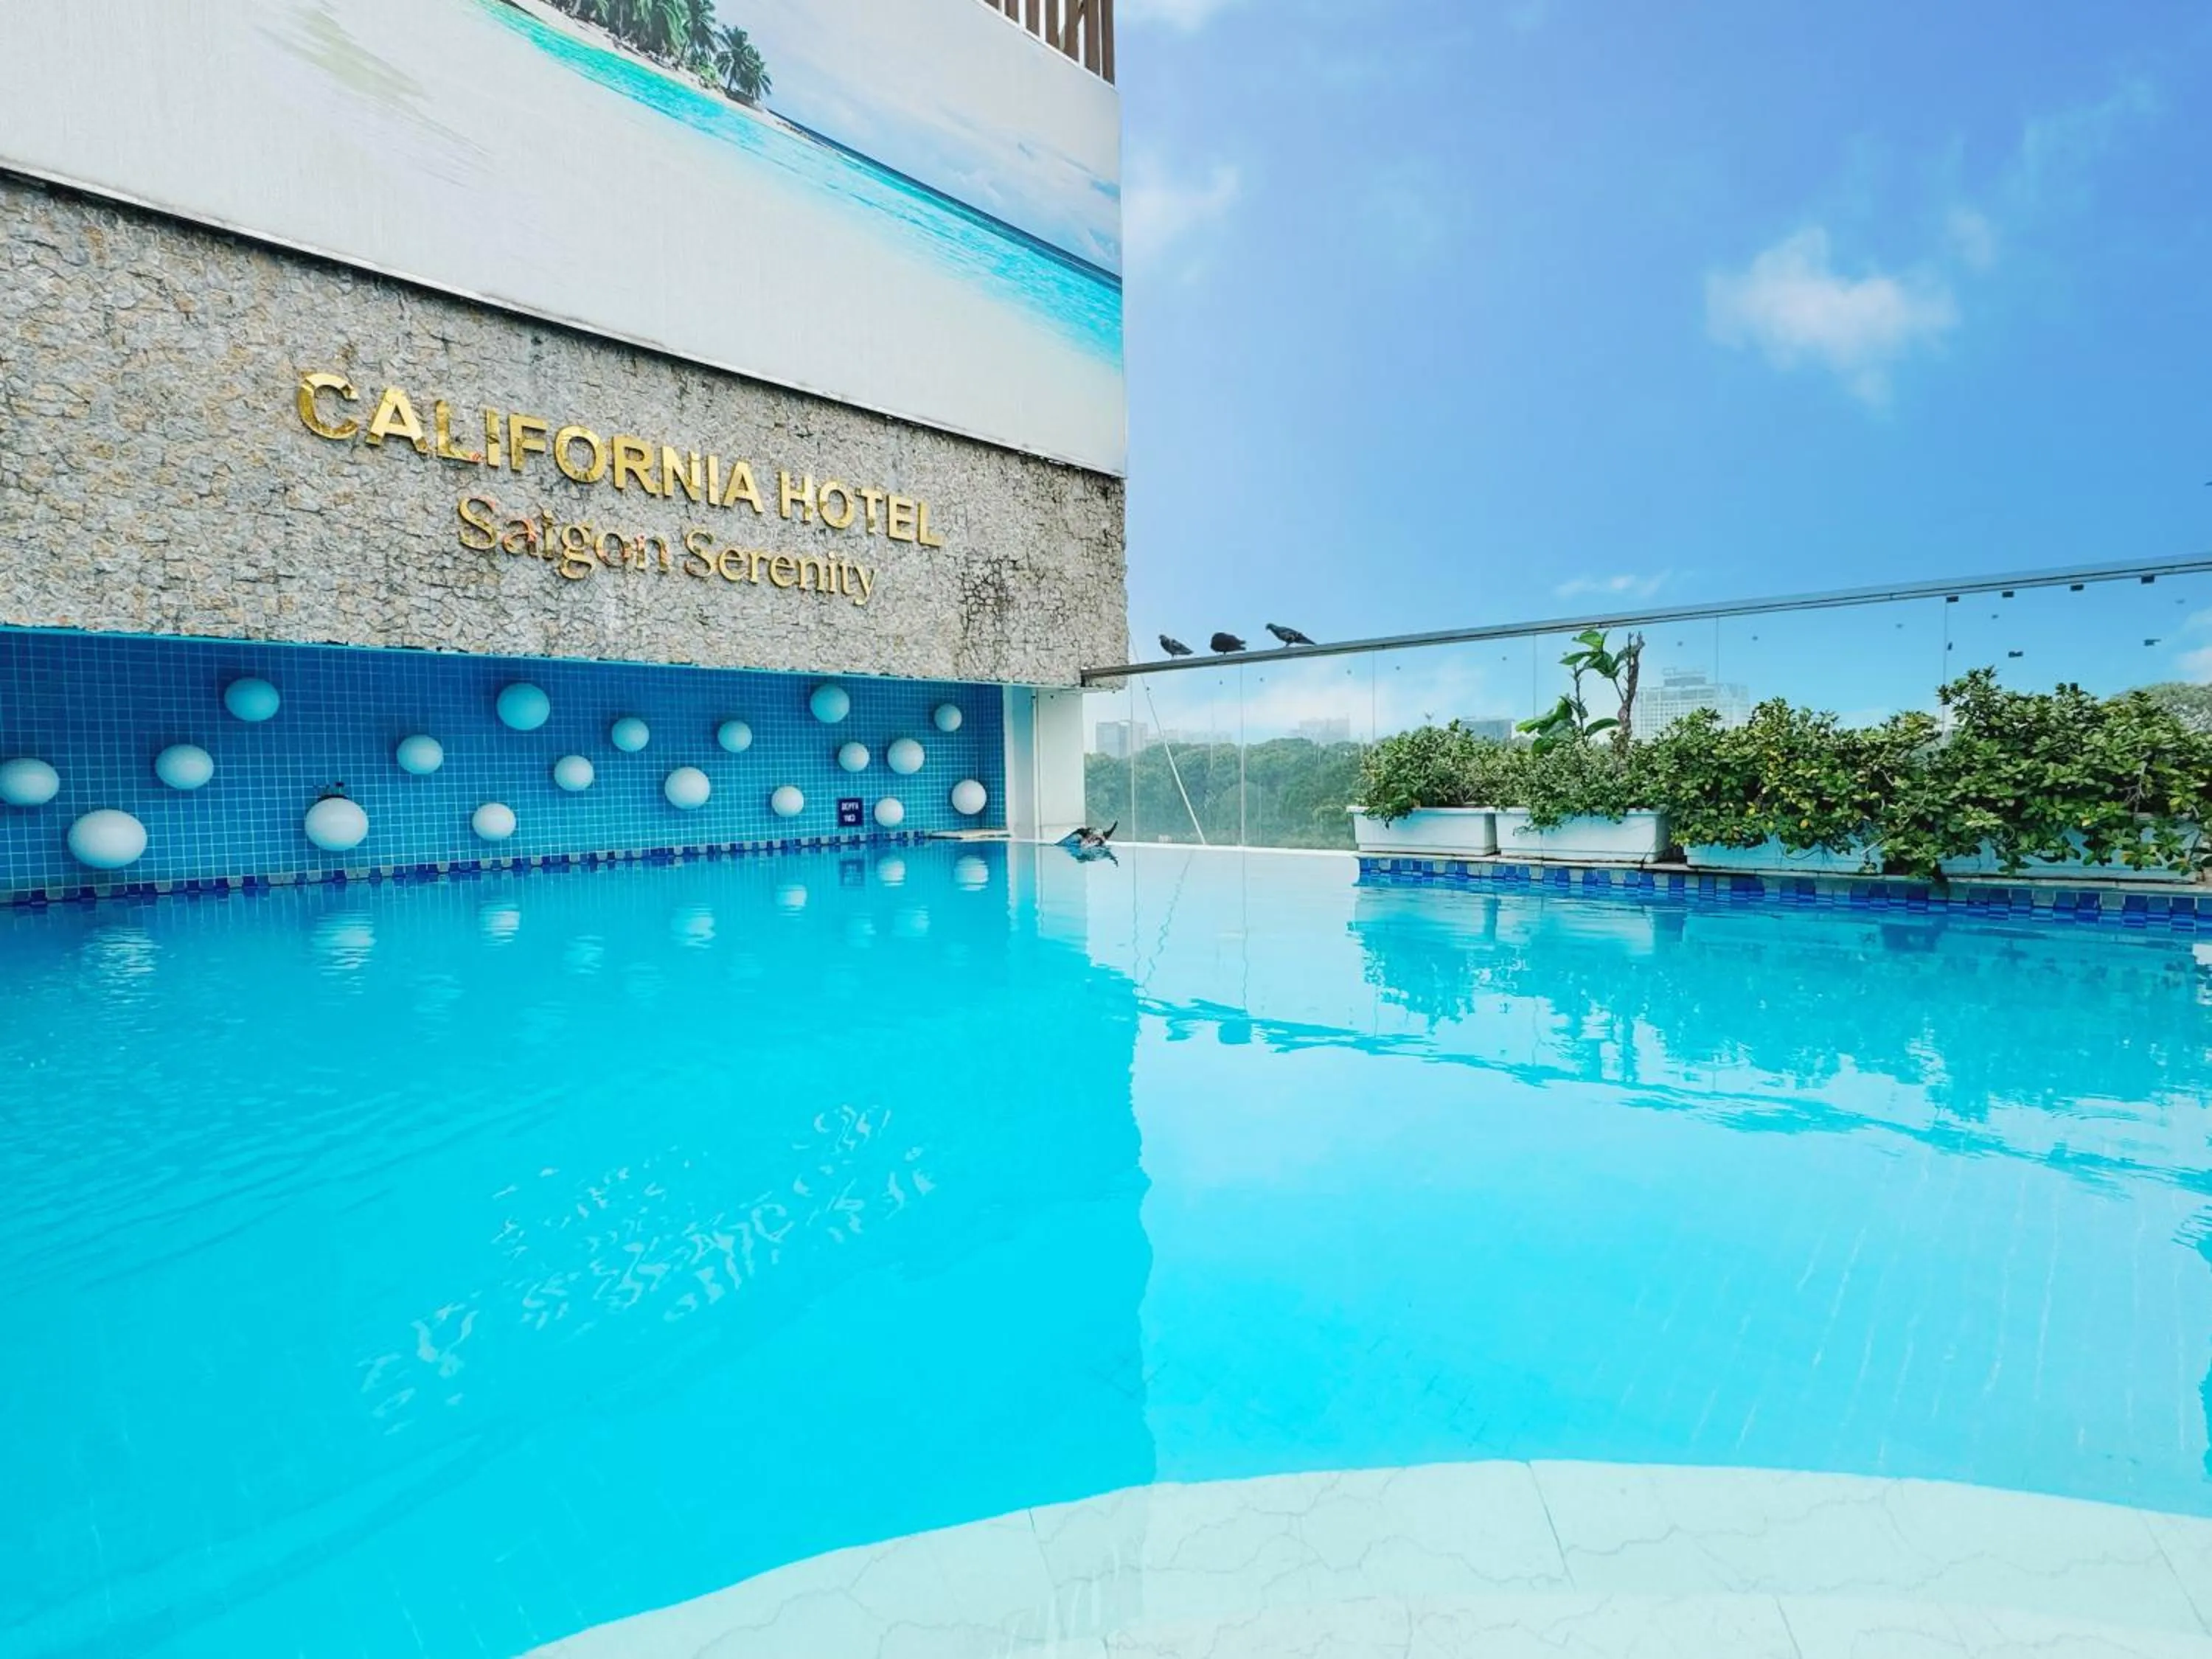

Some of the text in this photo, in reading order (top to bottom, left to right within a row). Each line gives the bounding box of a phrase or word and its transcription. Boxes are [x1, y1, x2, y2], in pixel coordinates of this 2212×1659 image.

[296, 372, 943, 548] CALIFORNIA HOTEL
[458, 495, 878, 605] Saigon Serenity
